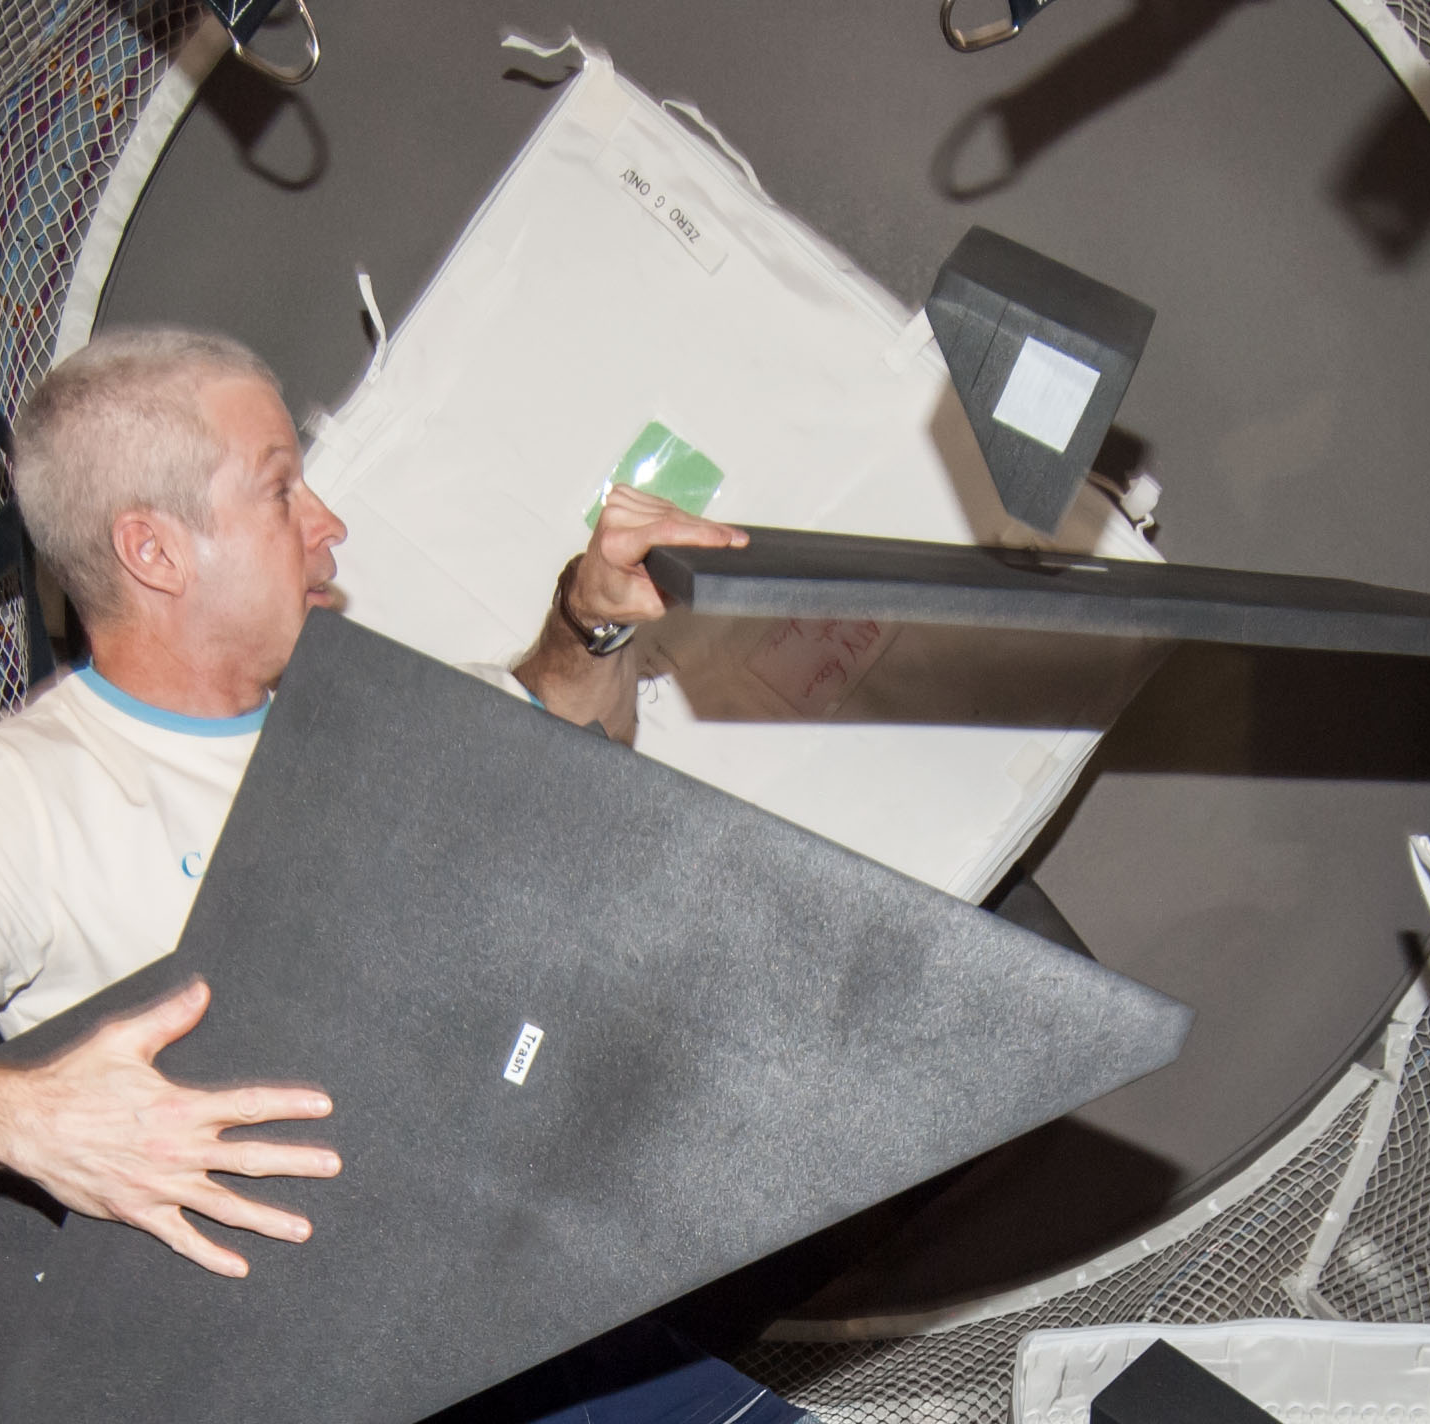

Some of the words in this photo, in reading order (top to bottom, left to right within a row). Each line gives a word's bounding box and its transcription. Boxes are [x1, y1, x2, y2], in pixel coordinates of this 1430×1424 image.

[619, 168, 651, 196] ONLY
[654, 195, 666, 208] G
[669, 208, 701, 244] ZERO
[511, 1034, 537, 1074] Trash
